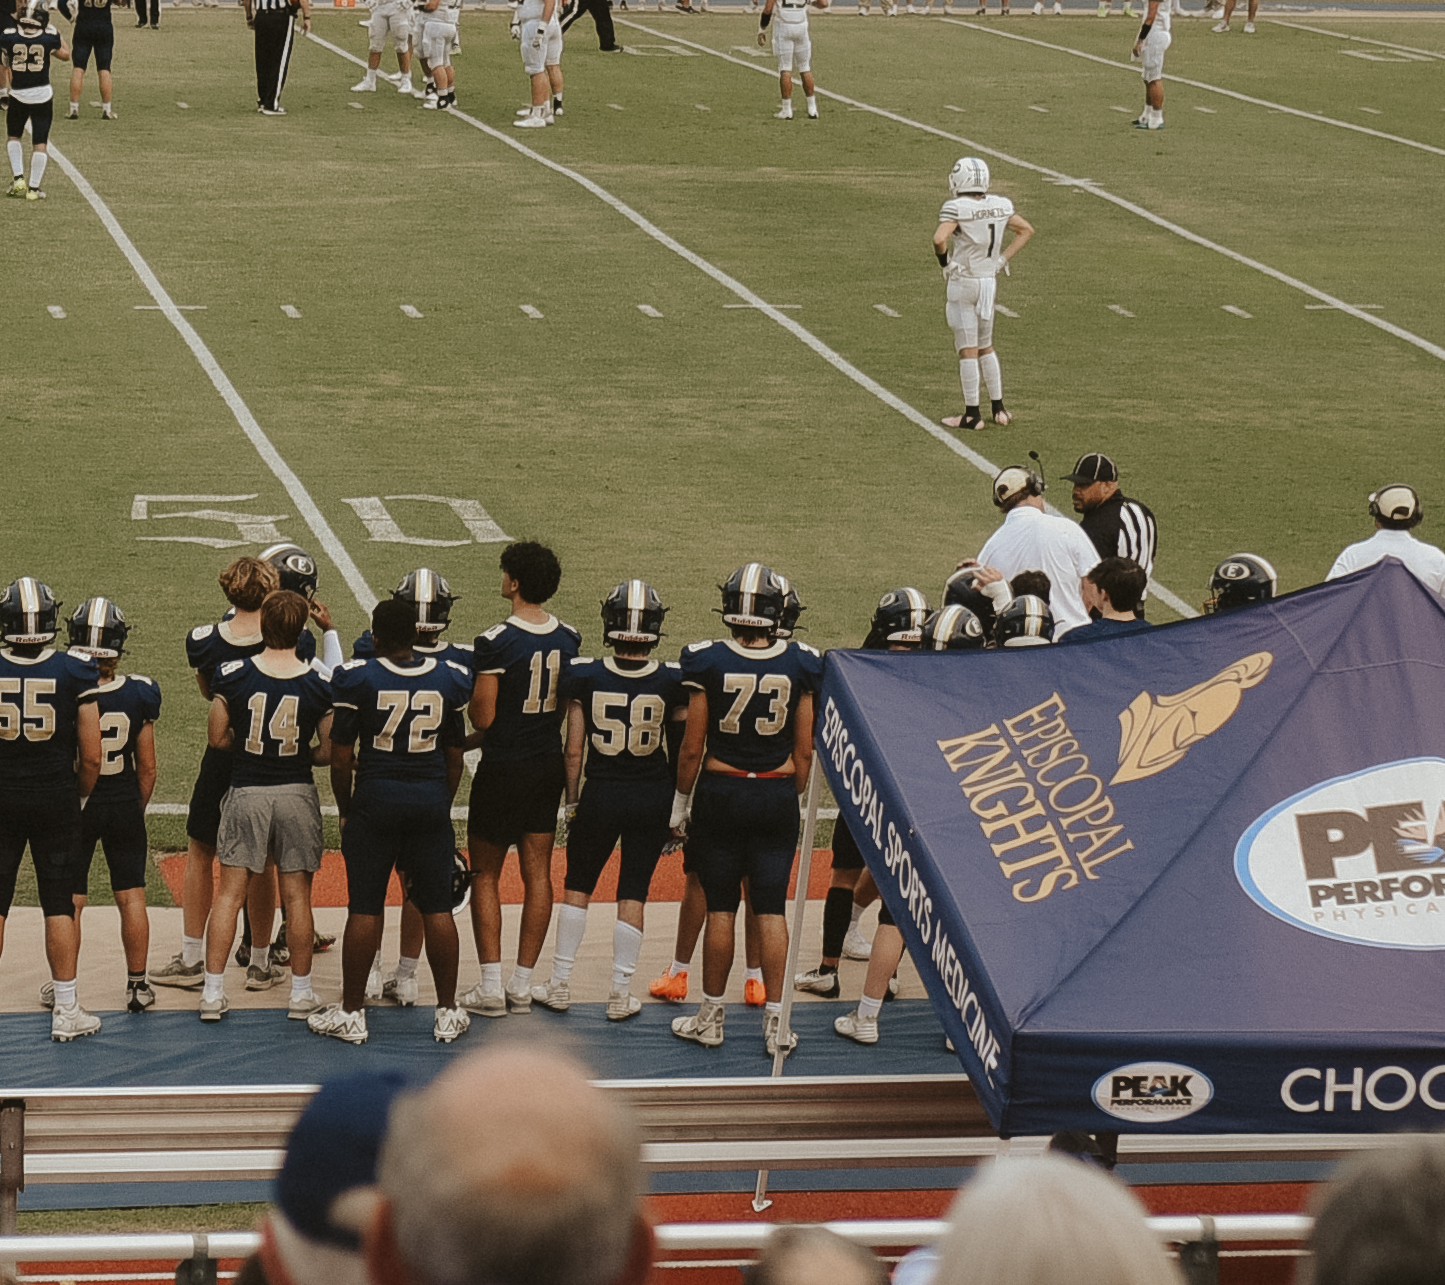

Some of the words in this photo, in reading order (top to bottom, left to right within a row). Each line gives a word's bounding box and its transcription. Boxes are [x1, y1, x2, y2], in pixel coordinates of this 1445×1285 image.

[11, 43, 45, 73] 23
[986, 223, 996, 258] 1
[522, 649, 561, 714] 11
[718, 672, 793, 736] 73
[245, 691, 300, 757] 14
[373, 689, 444, 753] 72
[591, 690, 666, 757] 58
[936, 723, 1081, 903] KNIGHTS
[1003, 691, 1135, 881] EPISCOPAL
[822, 695, 886, 851] EPISCOPAL
[883, 820, 934, 946] SPORTS
[932, 936, 1002, 1090] MEDICINE
[1111, 1098, 1192, 1106] PERFORMANCE
[1112, 1075, 1194, 1098] PEAK
